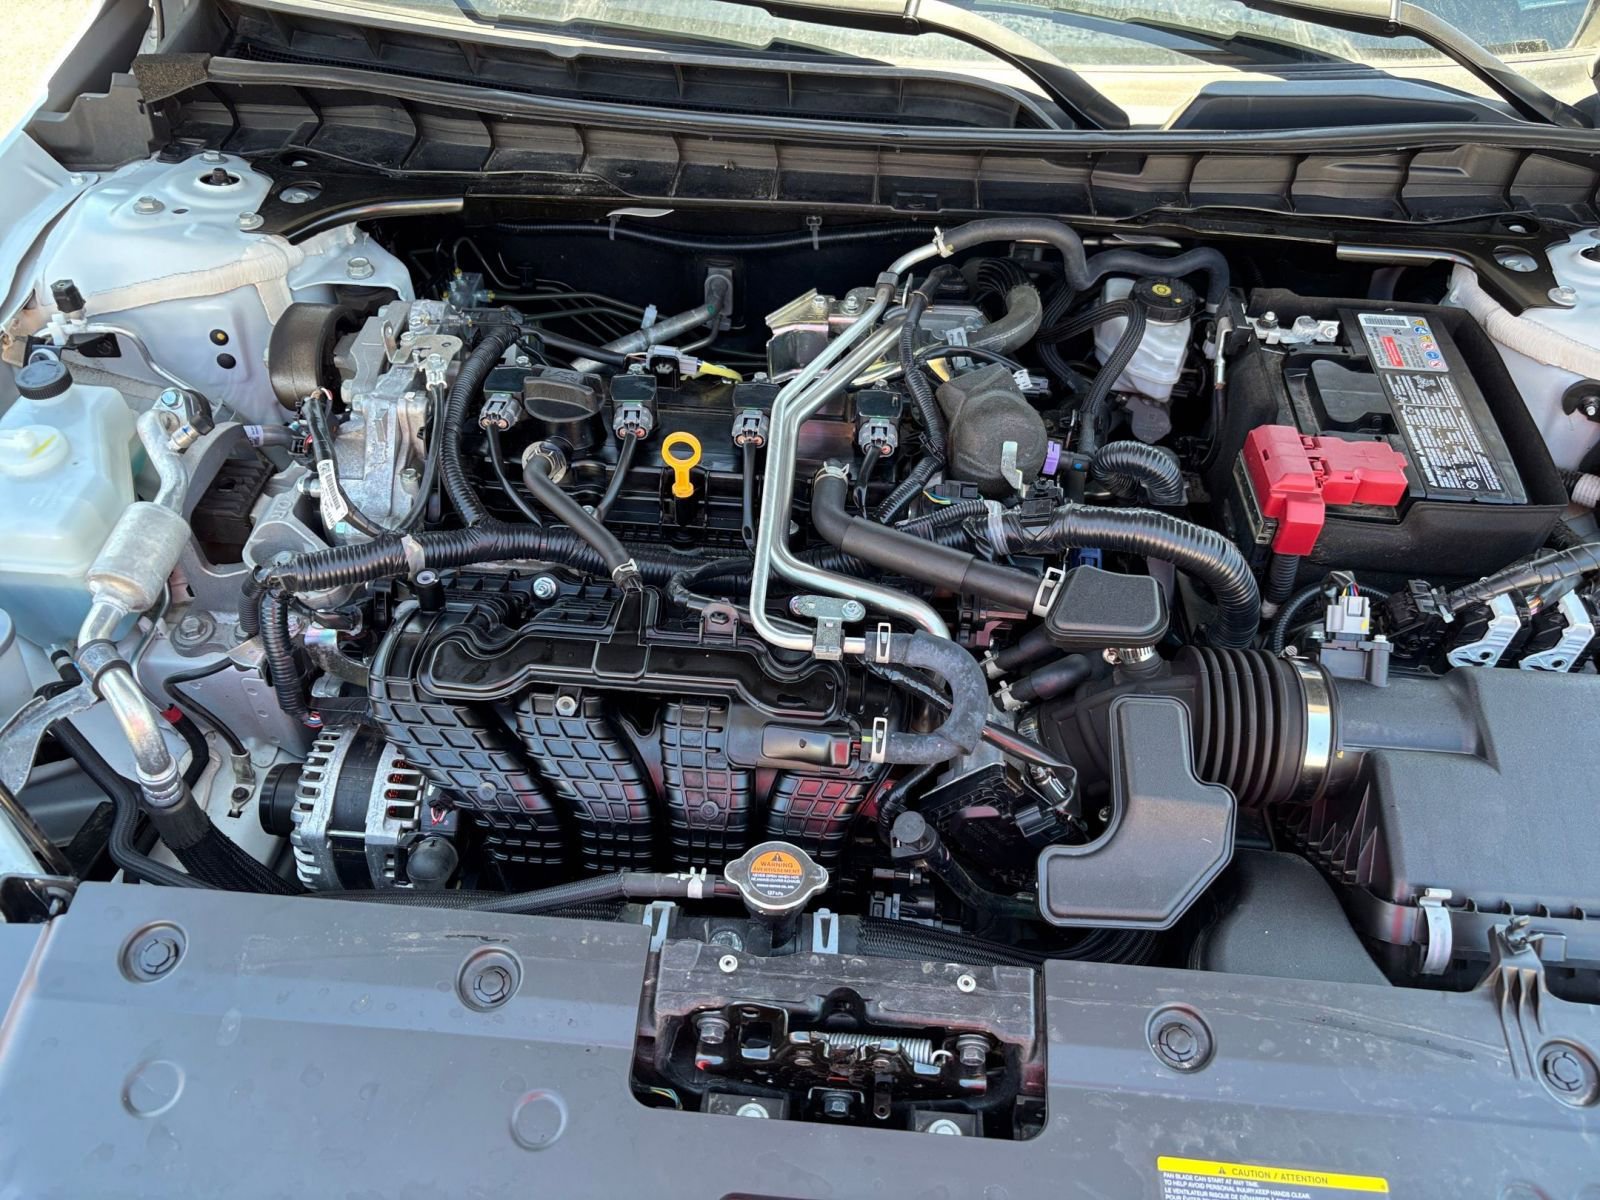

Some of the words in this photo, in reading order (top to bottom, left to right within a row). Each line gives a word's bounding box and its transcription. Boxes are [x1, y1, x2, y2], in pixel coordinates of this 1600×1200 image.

[1232, 1168, 1271, 1179] CAUTION
[1281, 1173, 1329, 1184] ATTENTION
[1188, 1181, 1204, 1189] AVOID
[1206, 1183, 1235, 1191] PERSONAL
[1172, 1187, 1207, 1196] VENTILATEUR
